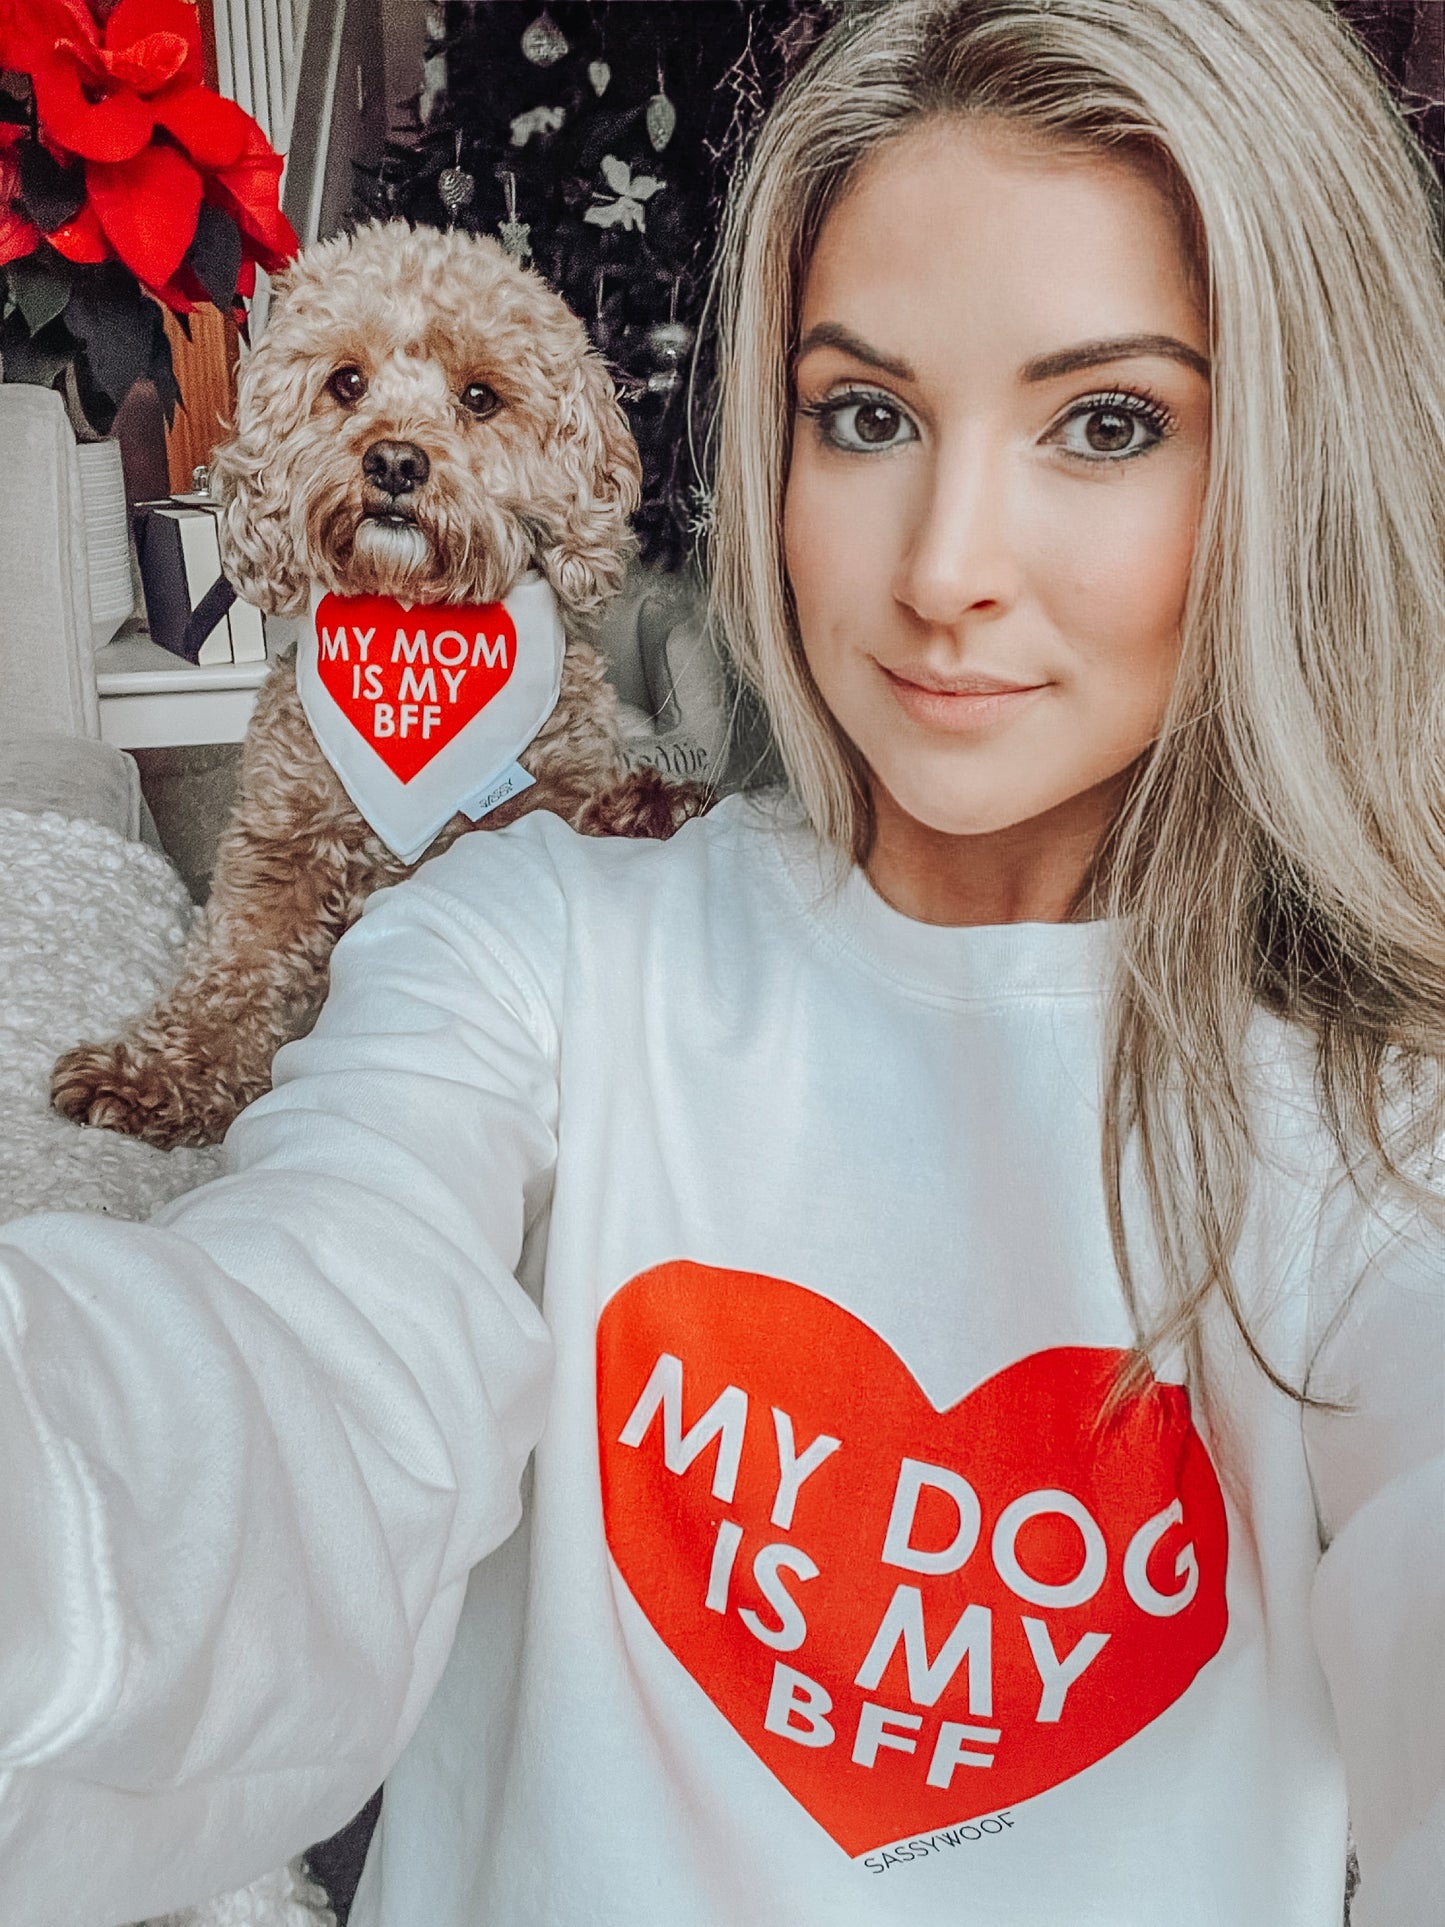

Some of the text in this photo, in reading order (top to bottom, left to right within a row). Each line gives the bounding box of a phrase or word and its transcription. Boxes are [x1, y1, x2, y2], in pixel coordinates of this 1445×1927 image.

[321, 626, 508, 669] MY MOM
[352, 664, 467, 704] IS MY
[374, 703, 441, 740] BFF
[617, 1352, 1200, 1617] MY DOG
[704, 1518, 1112, 1723] IS MY
[763, 1660, 1002, 1790] BFF
[864, 1811, 1015, 1874] SASSYWOOF
